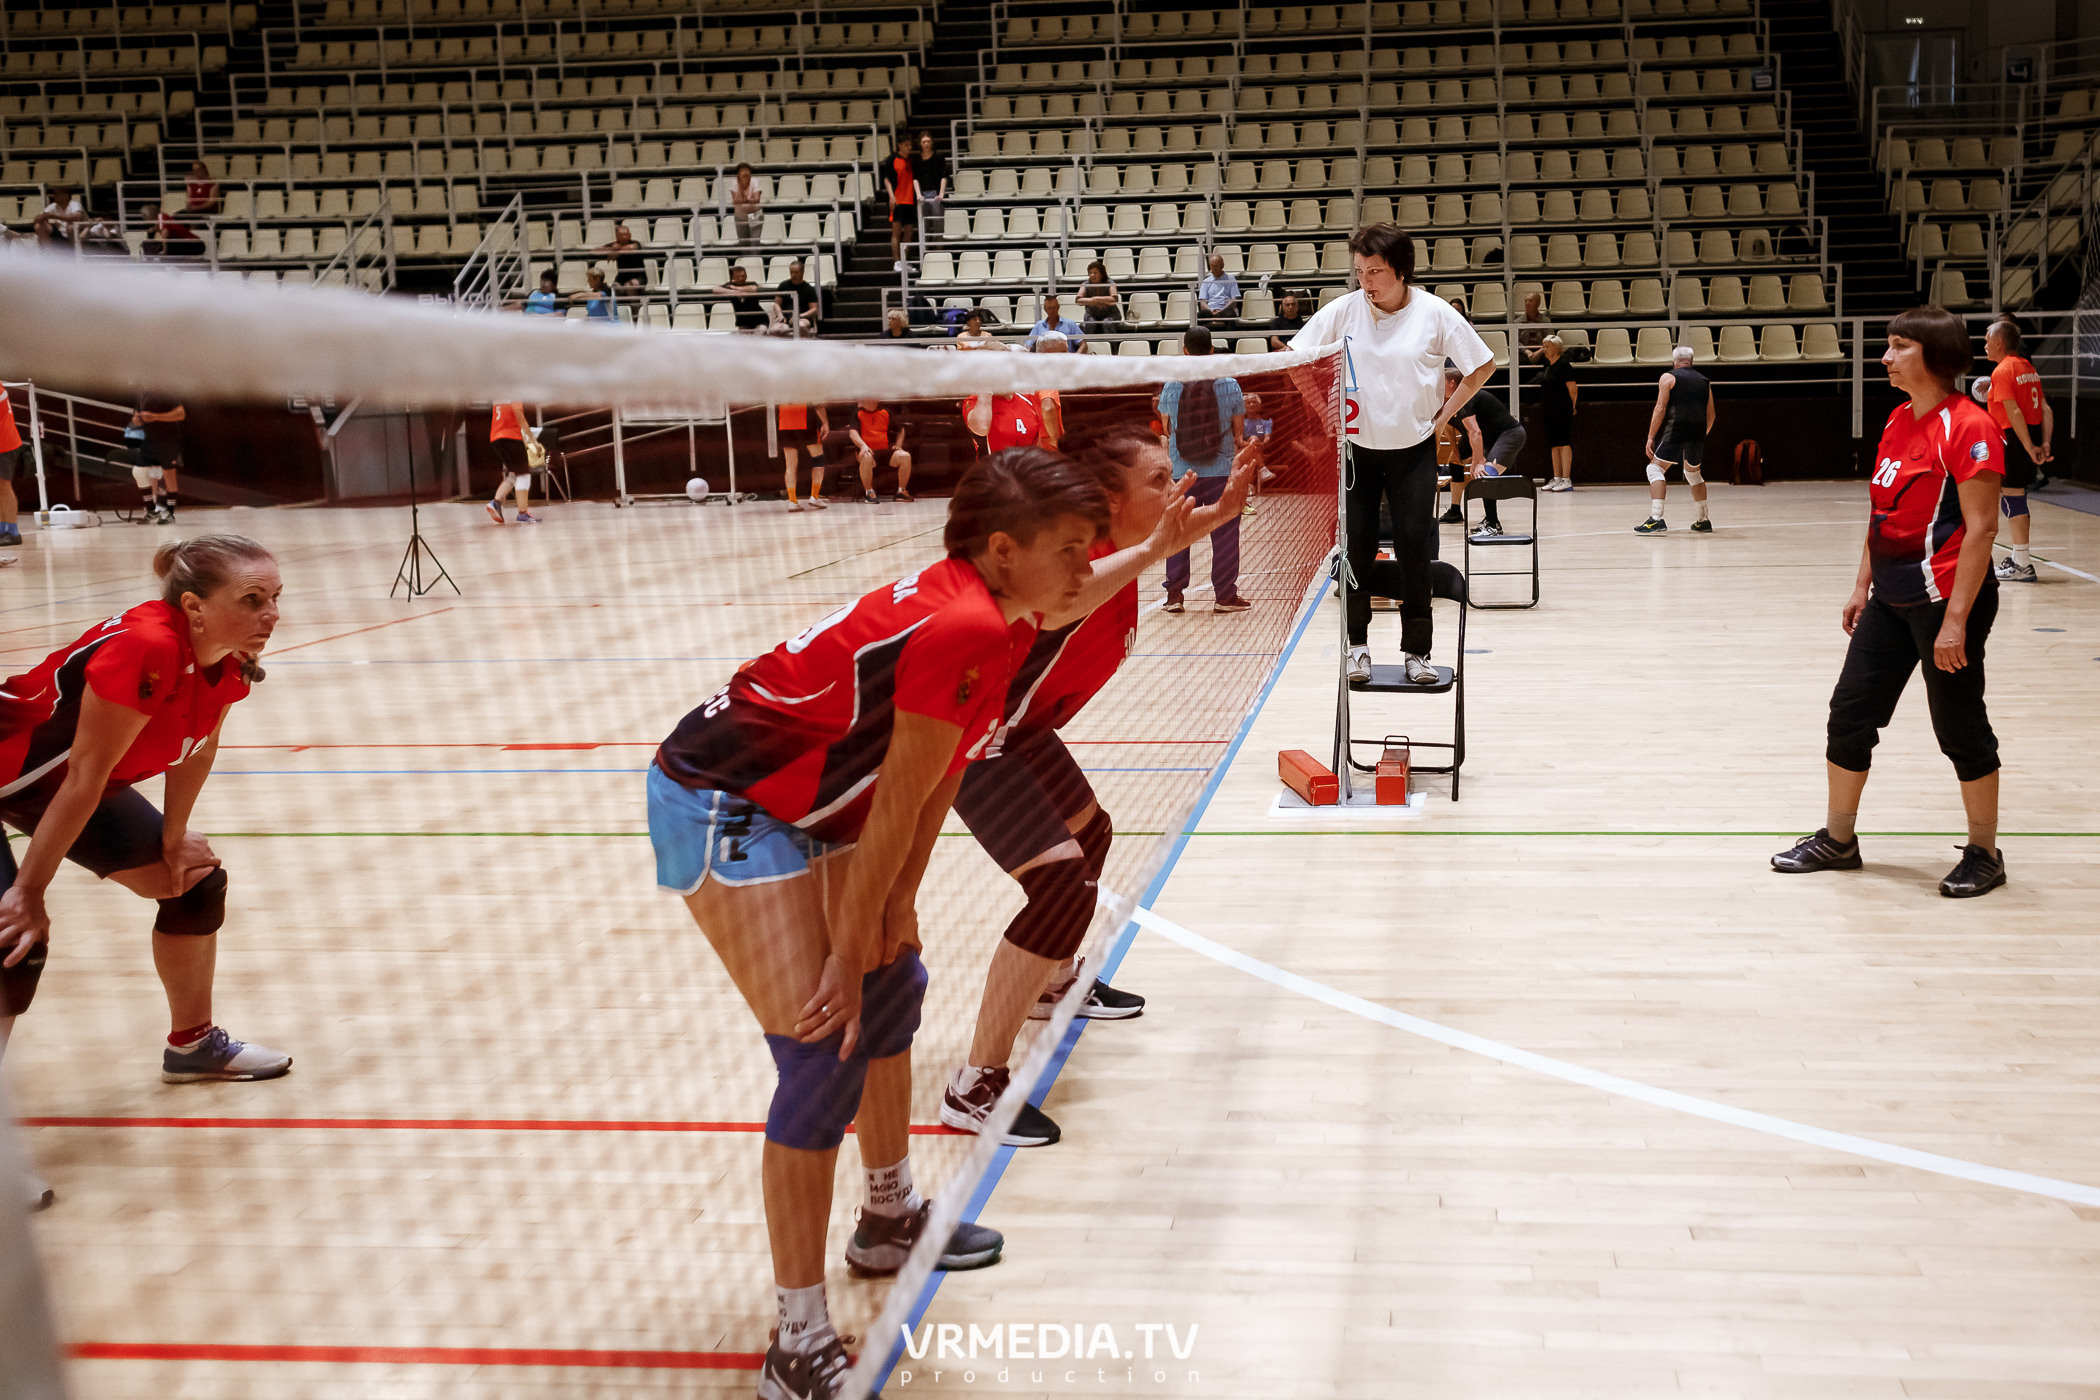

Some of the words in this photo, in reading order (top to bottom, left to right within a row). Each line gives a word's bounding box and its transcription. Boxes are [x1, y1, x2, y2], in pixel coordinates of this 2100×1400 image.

[1016, 418, 1027, 434] 4
[1871, 457, 1902, 488] 26
[883, 1168, 899, 1181] НЕ
[869, 1180, 899, 1193] МОЮ
